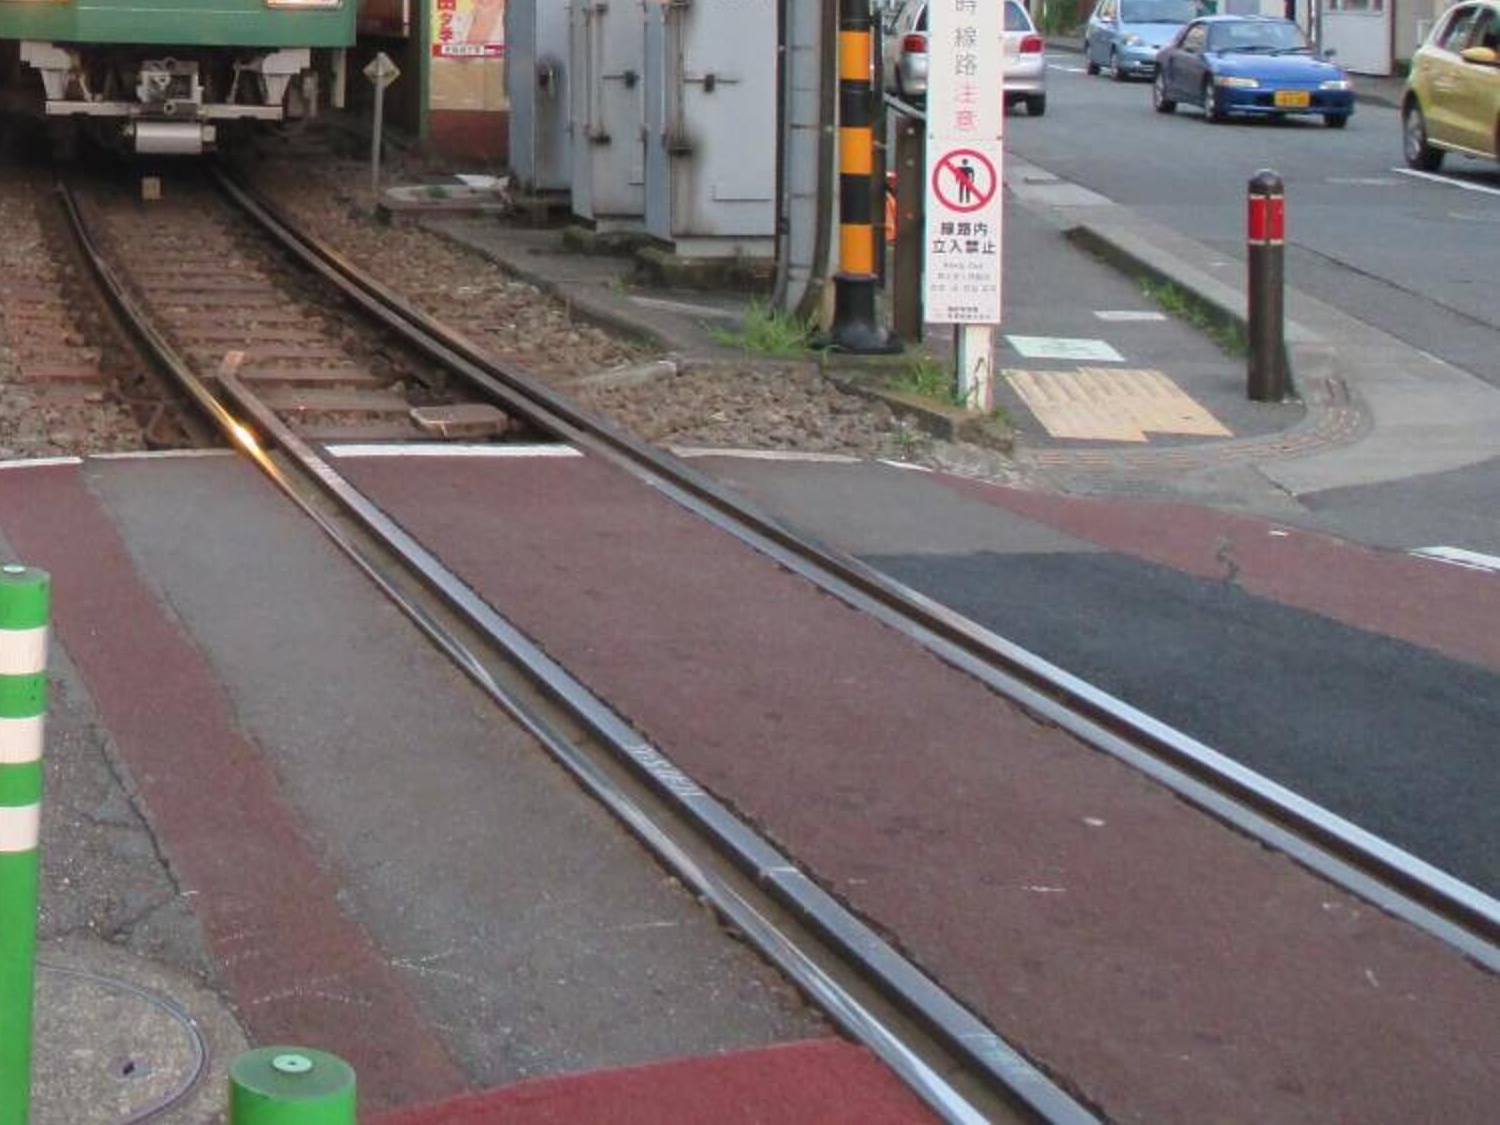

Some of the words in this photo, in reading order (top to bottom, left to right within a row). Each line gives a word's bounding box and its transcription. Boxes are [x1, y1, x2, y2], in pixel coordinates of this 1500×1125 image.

[940, 221, 989, 236] 線路内
[931, 239, 997, 254] 立入禁止
